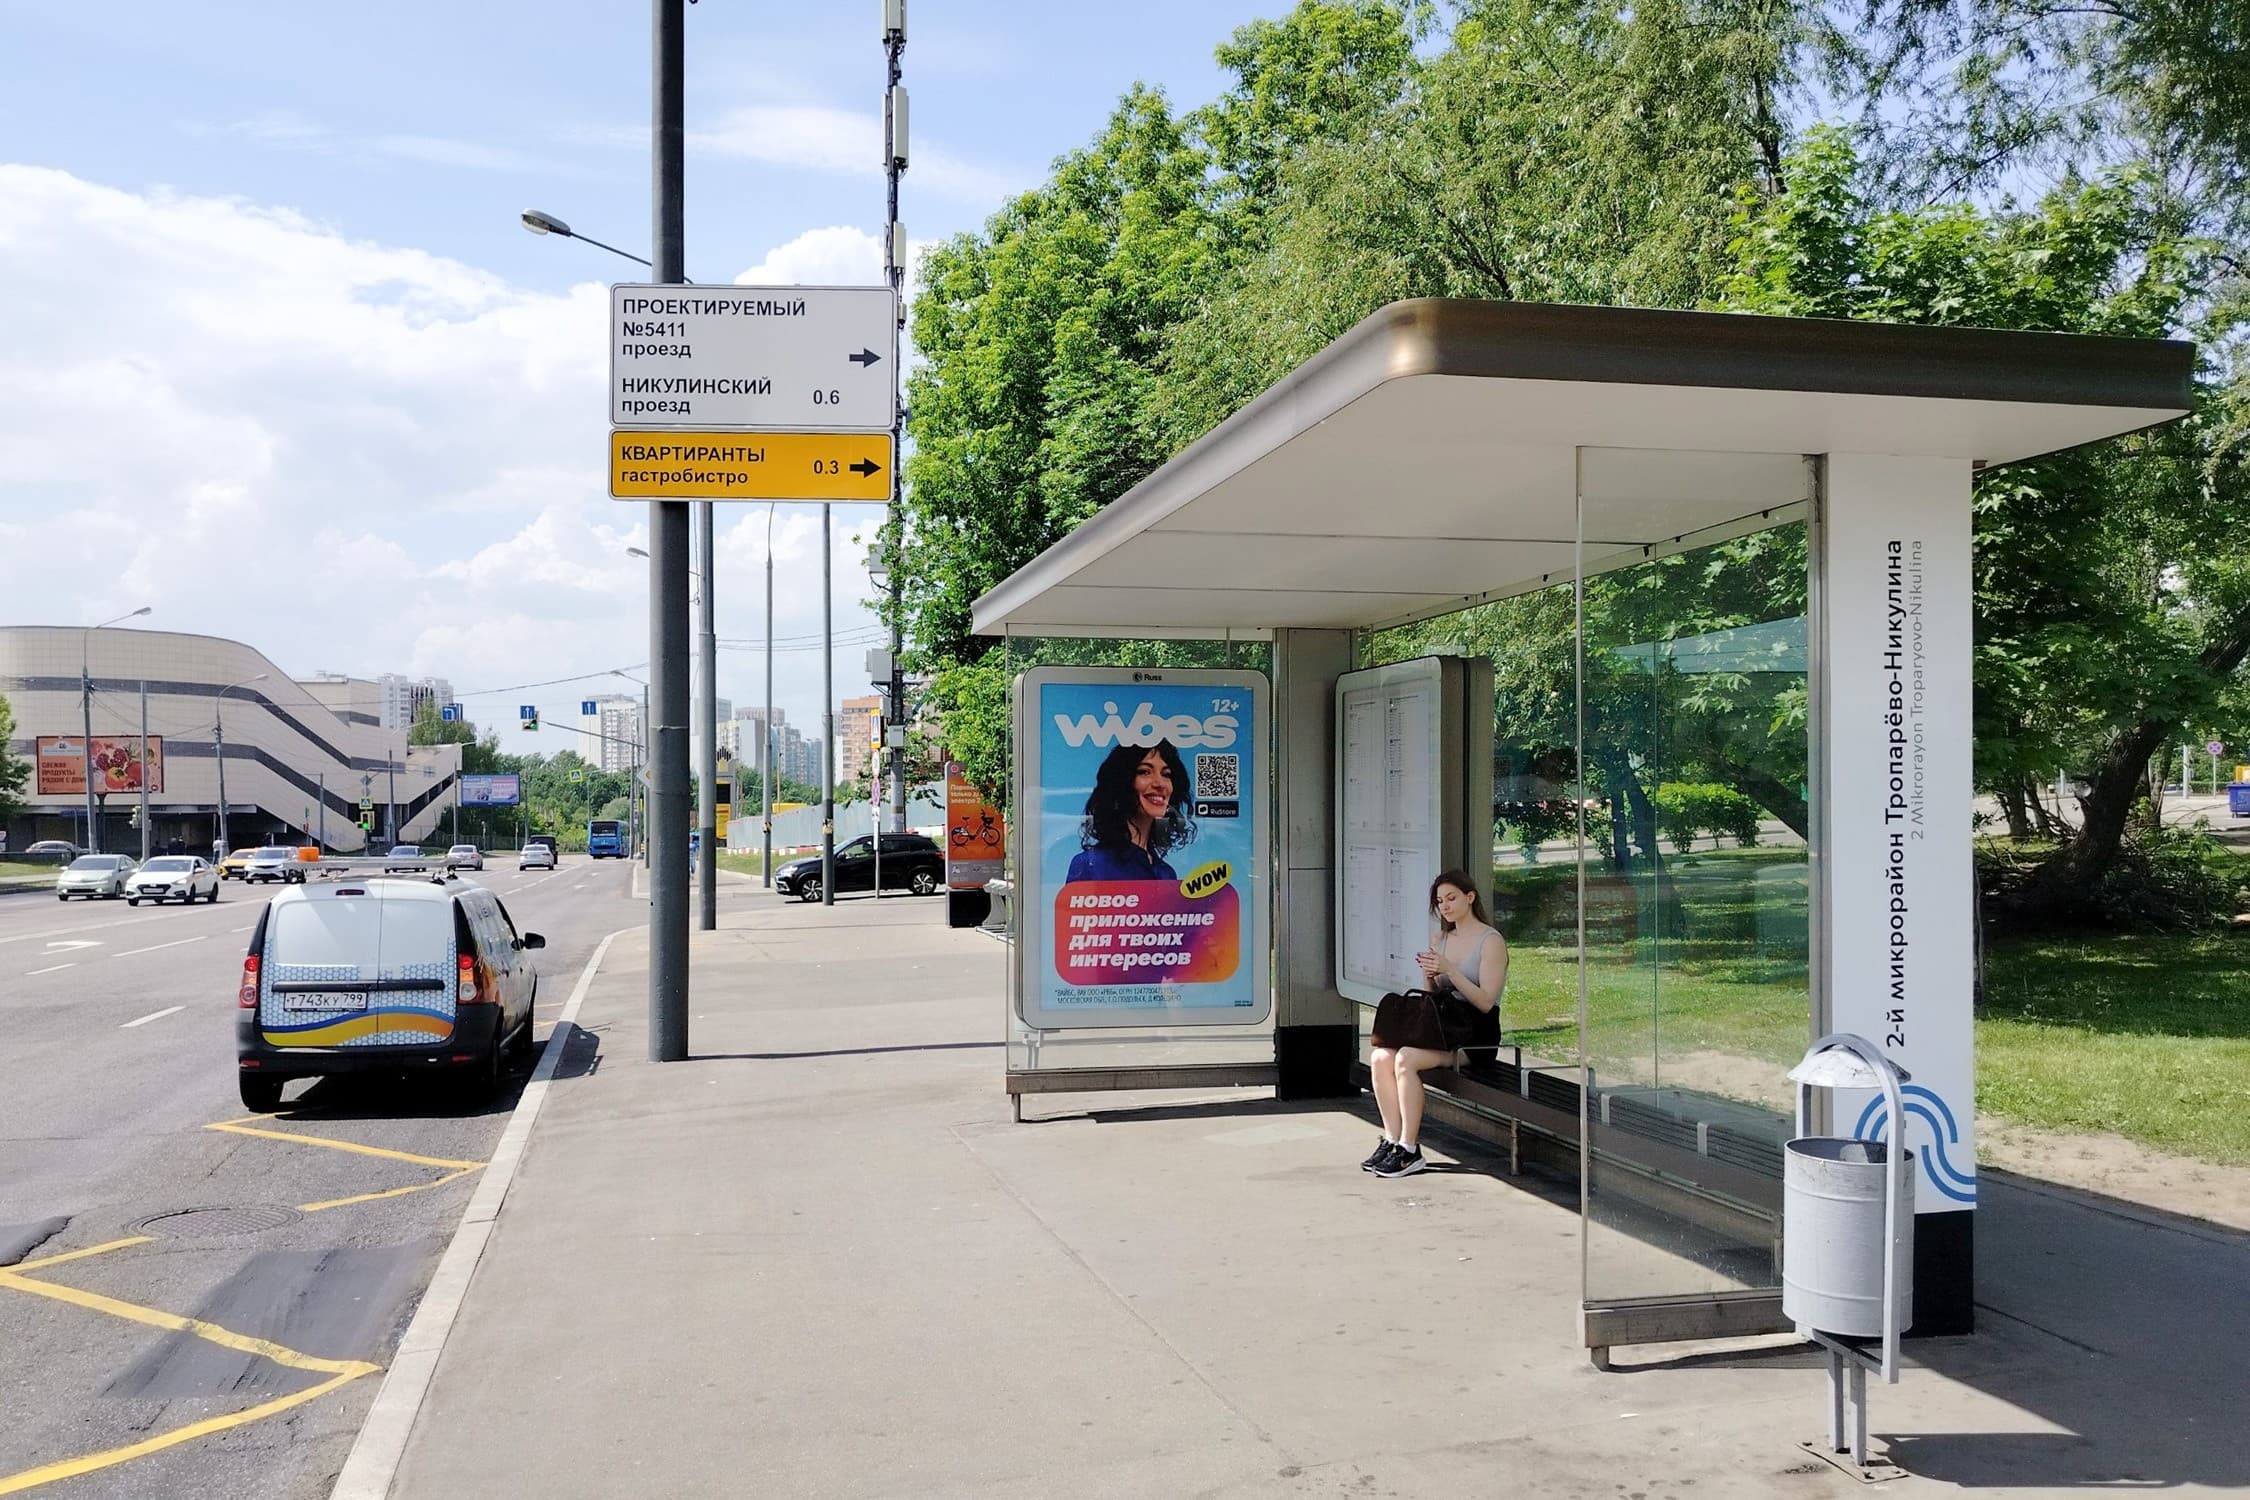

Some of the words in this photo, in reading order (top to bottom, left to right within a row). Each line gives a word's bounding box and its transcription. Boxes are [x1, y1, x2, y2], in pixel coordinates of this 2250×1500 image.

[623, 298, 806, 317] ПРОЕКТИРУЕМЫЙ
[623, 322, 686, 337] №5411
[622, 343, 692, 359] проезд
[621, 376, 772, 395] НИКУЛИНСКИЙ
[813, 390, 840, 405] 0.6
[621, 399, 691, 415] проезд
[621, 446, 765, 462] КВАРТИРАНТЫ
[813, 460, 840, 475] 0.3
[621, 469, 748, 487] гастробистро
[1908, 540, 1926, 717] Troparyovo-Nikulina
[1144, 673, 1162, 681] Russ
[1883, 540, 1908, 825] Тропарёво-Никулина
[1211, 699, 1240, 713] 12+
[1054, 701, 1240, 748] wibes
[1910, 723, 1926, 825] Mikrorayon
[1911, 830, 1924, 840] 2
[1069, 894, 1139, 908] новое
[1069, 913, 1215, 932] приложение
[1885, 833, 1908, 1000] микрорайон
[1068, 933, 1113, 951] для
[1118, 932, 1184, 947] твоих
[1069, 952, 1192, 971] интересов
[1886, 1009, 1905, 1047] 2-й
